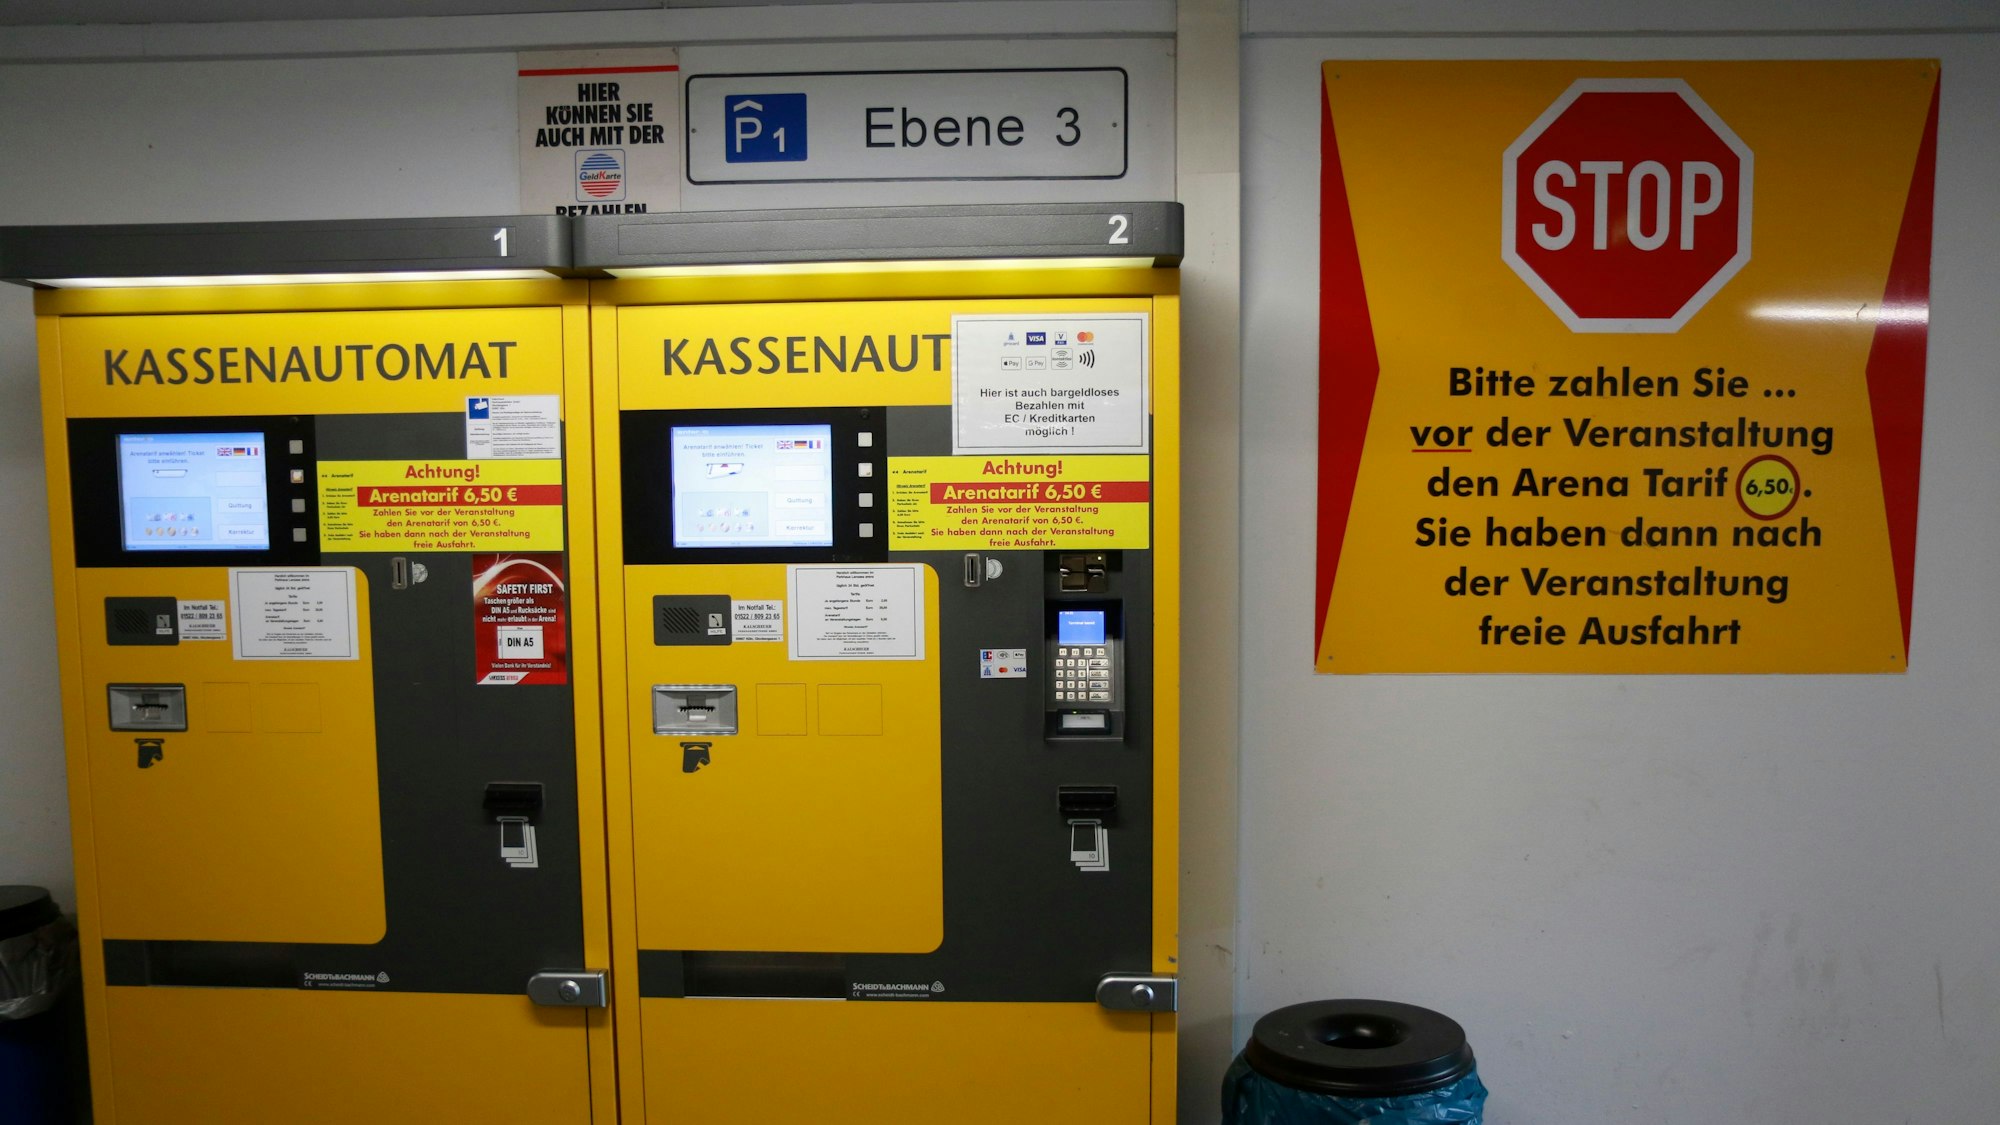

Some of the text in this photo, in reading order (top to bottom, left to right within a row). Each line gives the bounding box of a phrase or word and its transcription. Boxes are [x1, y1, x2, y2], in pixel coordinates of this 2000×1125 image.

[578, 82, 620, 102] HIER
[546, 103, 653, 125] KÖNNEN SIE
[535, 125, 664, 148] AUCH MIT DER
[864, 107, 1081, 148] Ebene 3
[580, 172, 621, 180] GeldKarte
[1532, 160, 1723, 252] STOP
[1108, 214, 1128, 244] 2
[493, 228, 508, 257] 1
[104, 341, 517, 386] KASSENAUTOMAT
[1448, 367, 1796, 397] Bitte zahlen Sie ...
[980, 389, 1001, 397] Hier
[1051, 388, 1119, 399] bargeldloses
[1016, 402, 1064, 410] Bezahlen
[1005, 414, 1095, 423] EC / Kreditkarten
[1025, 427, 1074, 437] möglich !
[1410, 417, 1834, 455] vor der Veranstaltung
[405, 464, 480, 482] Achtung!
[982, 460, 1062, 479] Achtung!
[1426, 468, 1498, 497] den
[1512, 468, 1629, 497] Arena
[1644, 468, 1728, 497] Tarif
[369, 487, 517, 505] Arenatarif 6,50 €
[943, 484, 1102, 502] Arenatarif 6,50 €
[455, 509, 514, 518] Veranstaltung
[1035, 506, 1098, 514] Veranstaltung
[1053, 517, 1072, 525] 6,50
[470, 530, 530, 539] Veranstaltung
[1051, 528, 1114, 538] Veranstaltung
[1415, 518, 1822, 548] Sie haben dann nach
[497, 584, 553, 594] SAFETY FIRST
[1444, 567, 1789, 604] der Veranstaltung
[507, 597, 524, 605] größer
[1479, 616, 1740, 645] freie Ausfahrt
[508, 638, 521, 647] DIN
[524, 638, 534, 647] A5
